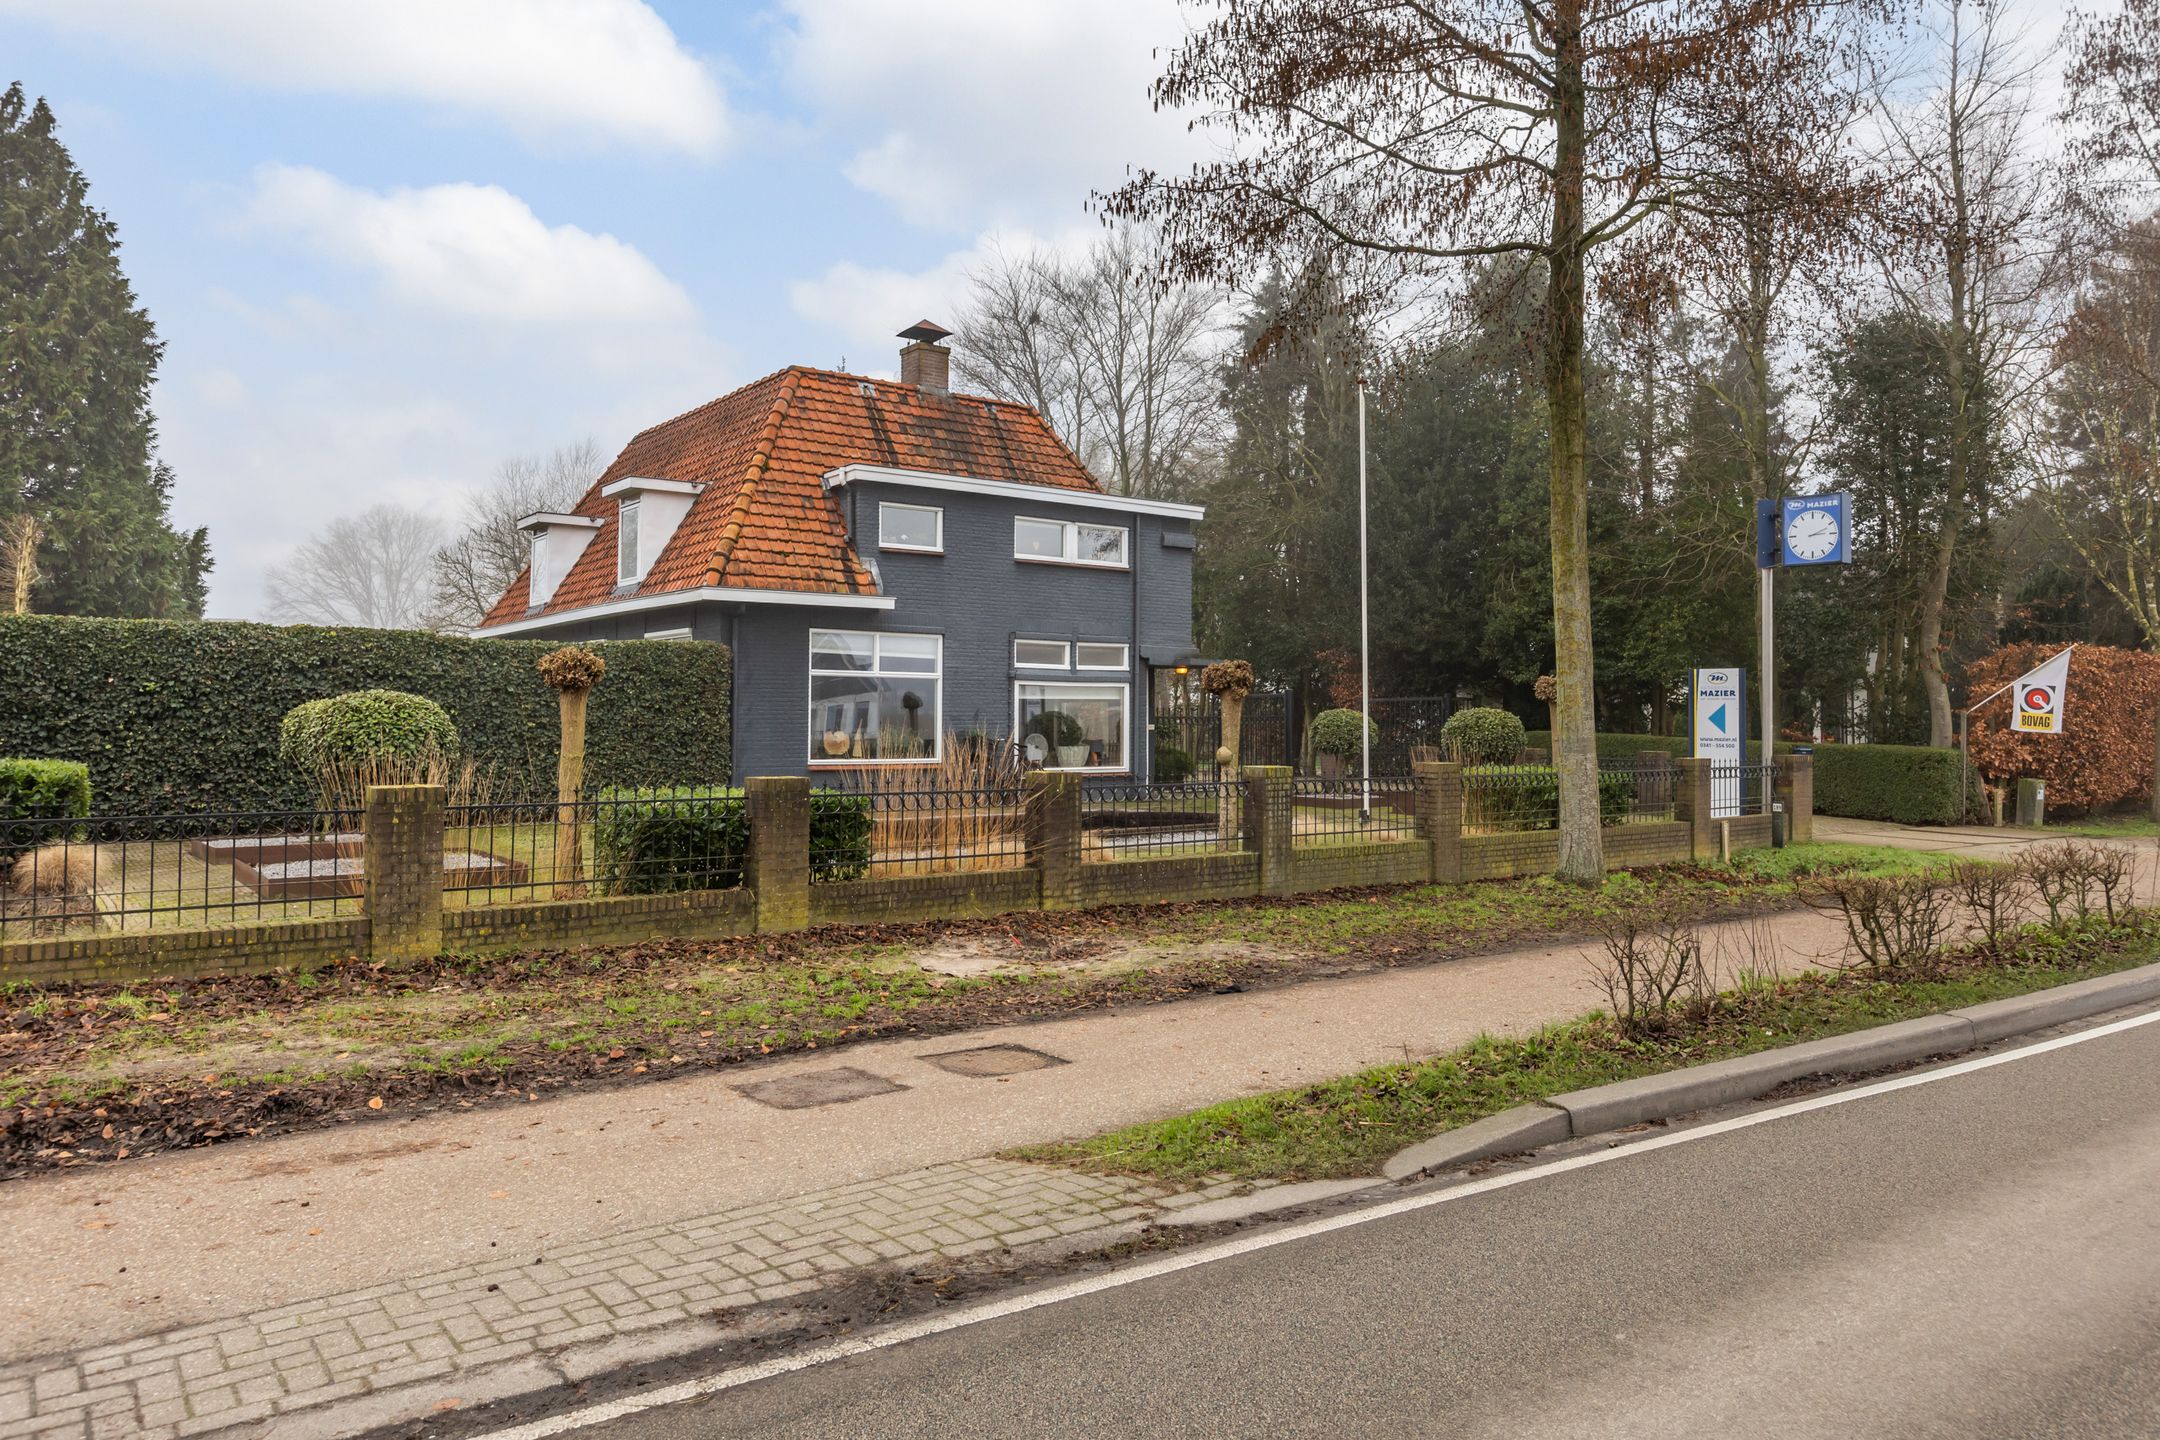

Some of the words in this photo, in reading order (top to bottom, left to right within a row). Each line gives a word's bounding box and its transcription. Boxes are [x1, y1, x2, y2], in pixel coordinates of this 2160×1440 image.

[1807, 500, 1839, 509] MAZIER
[1700, 689, 1736, 697] MAZIER
[2021, 715, 2050, 728] BOVAG
